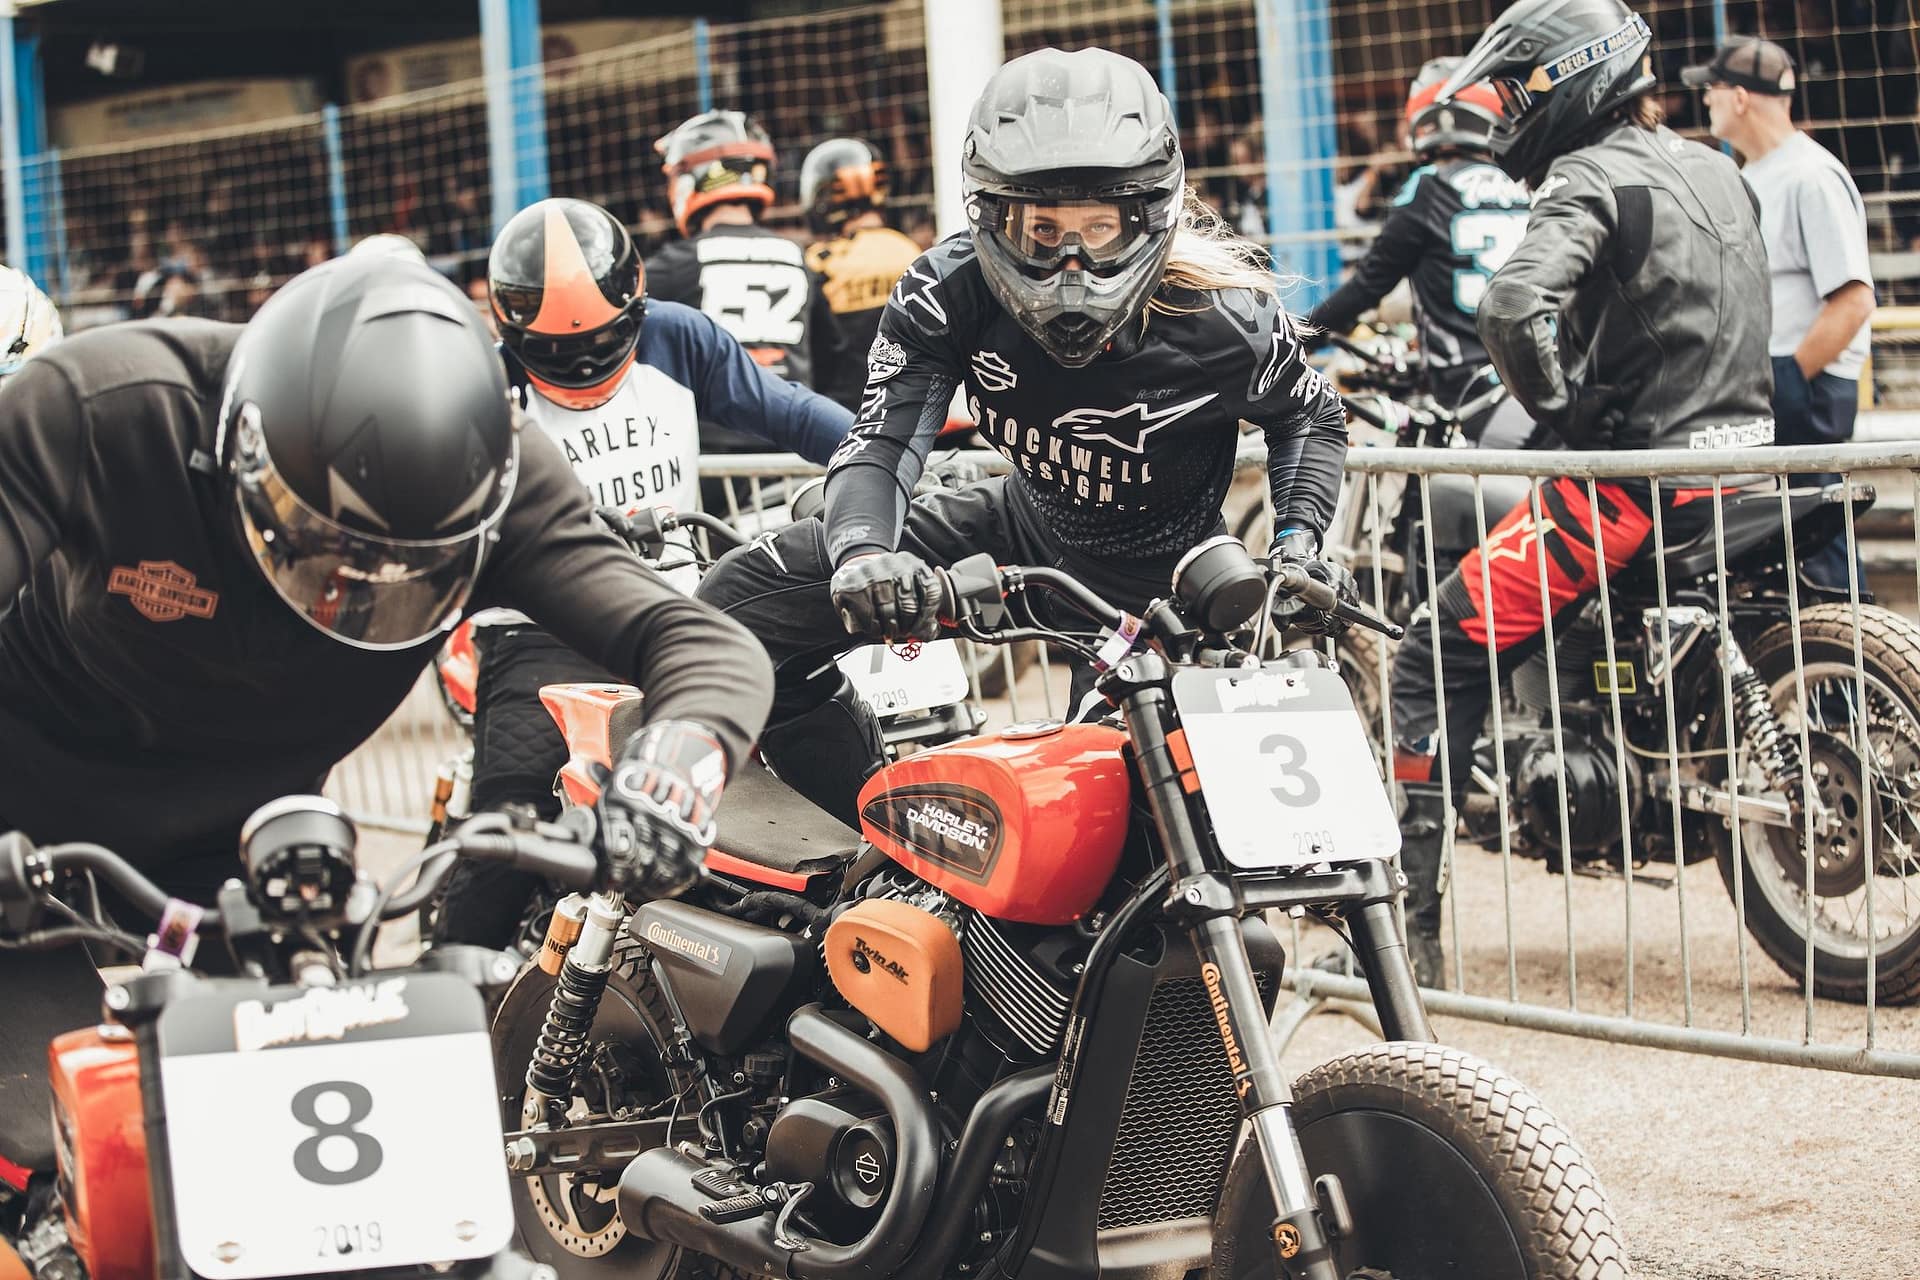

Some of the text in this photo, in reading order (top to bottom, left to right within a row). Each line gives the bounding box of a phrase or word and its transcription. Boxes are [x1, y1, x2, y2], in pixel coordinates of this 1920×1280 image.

[1557, 49, 1589, 77] DEUS
[1591, 42, 1607, 60] EX
[563, 416, 670, 464] ARLEY-
[969, 395, 1152, 485] STOCKWELL
[598, 456, 681, 507] IDSON
[999, 444, 1113, 503] DESIGN
[872, 688, 910, 710] 2019
[1259, 734, 1321, 808] 3
[906, 808, 986, 852] DAVIDSON
[923, 803, 989, 837] HARLEY-
[1293, 830, 1335, 856] 2019
[547, 937, 567, 956] INS
[648, 922, 711, 961] Continental
[855, 936, 887, 965] Twin
[886, 961, 909, 979] Air
[1201, 962, 1248, 1076] Continental
[291, 1080, 383, 1185] 8
[313, 1221, 383, 1257] 2019
